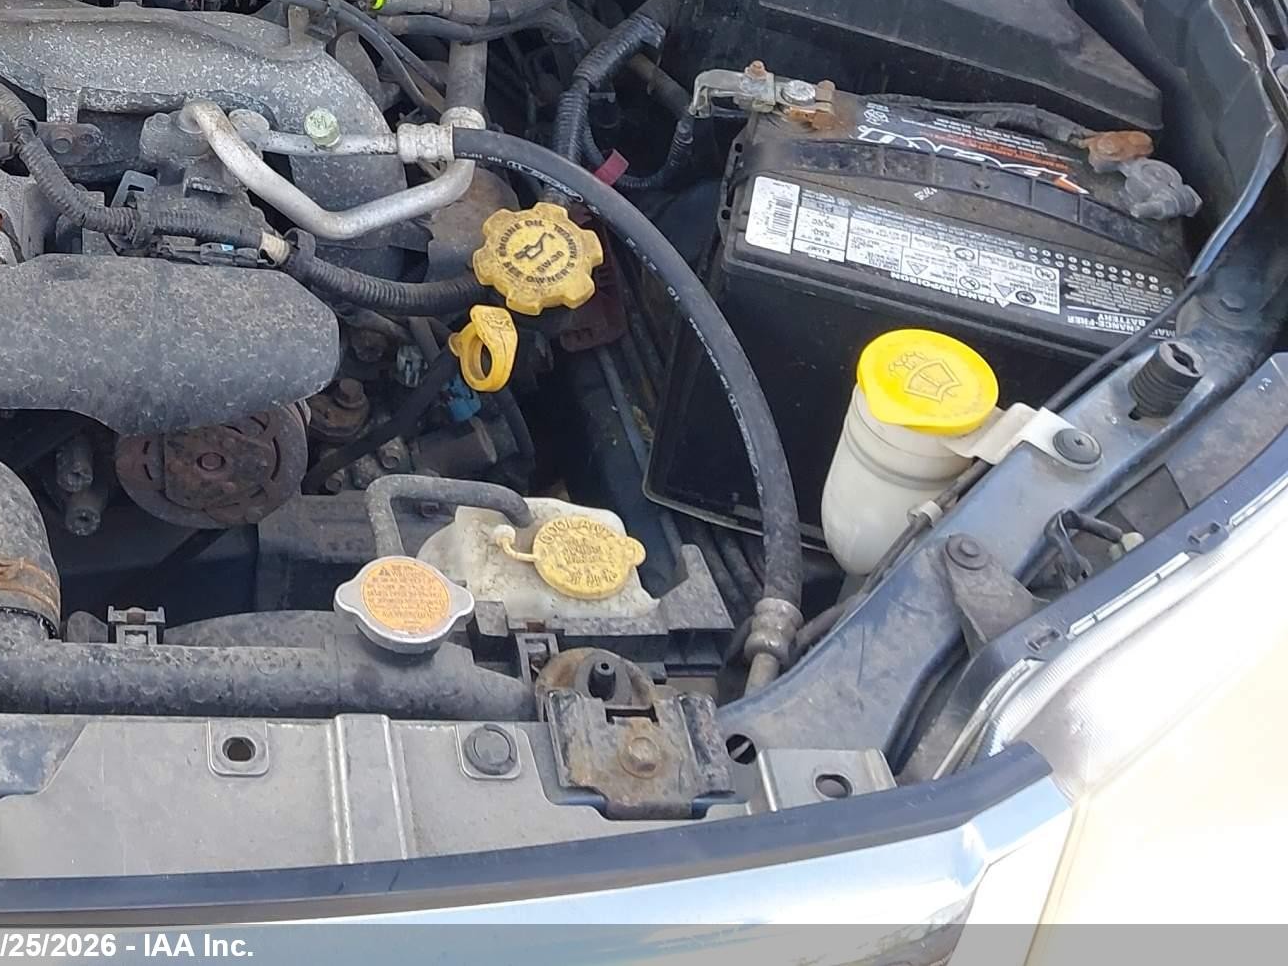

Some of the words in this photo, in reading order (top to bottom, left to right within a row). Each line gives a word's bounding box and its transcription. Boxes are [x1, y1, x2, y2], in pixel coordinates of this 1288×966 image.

[498, 222, 521, 257] ENGINE
[524, 219, 545, 228] OIL
[503, 261, 523, 278] SEE
[890, 270, 996, 305] DANGER/POISON
[1098, 313, 1146, 327] BATTERY
